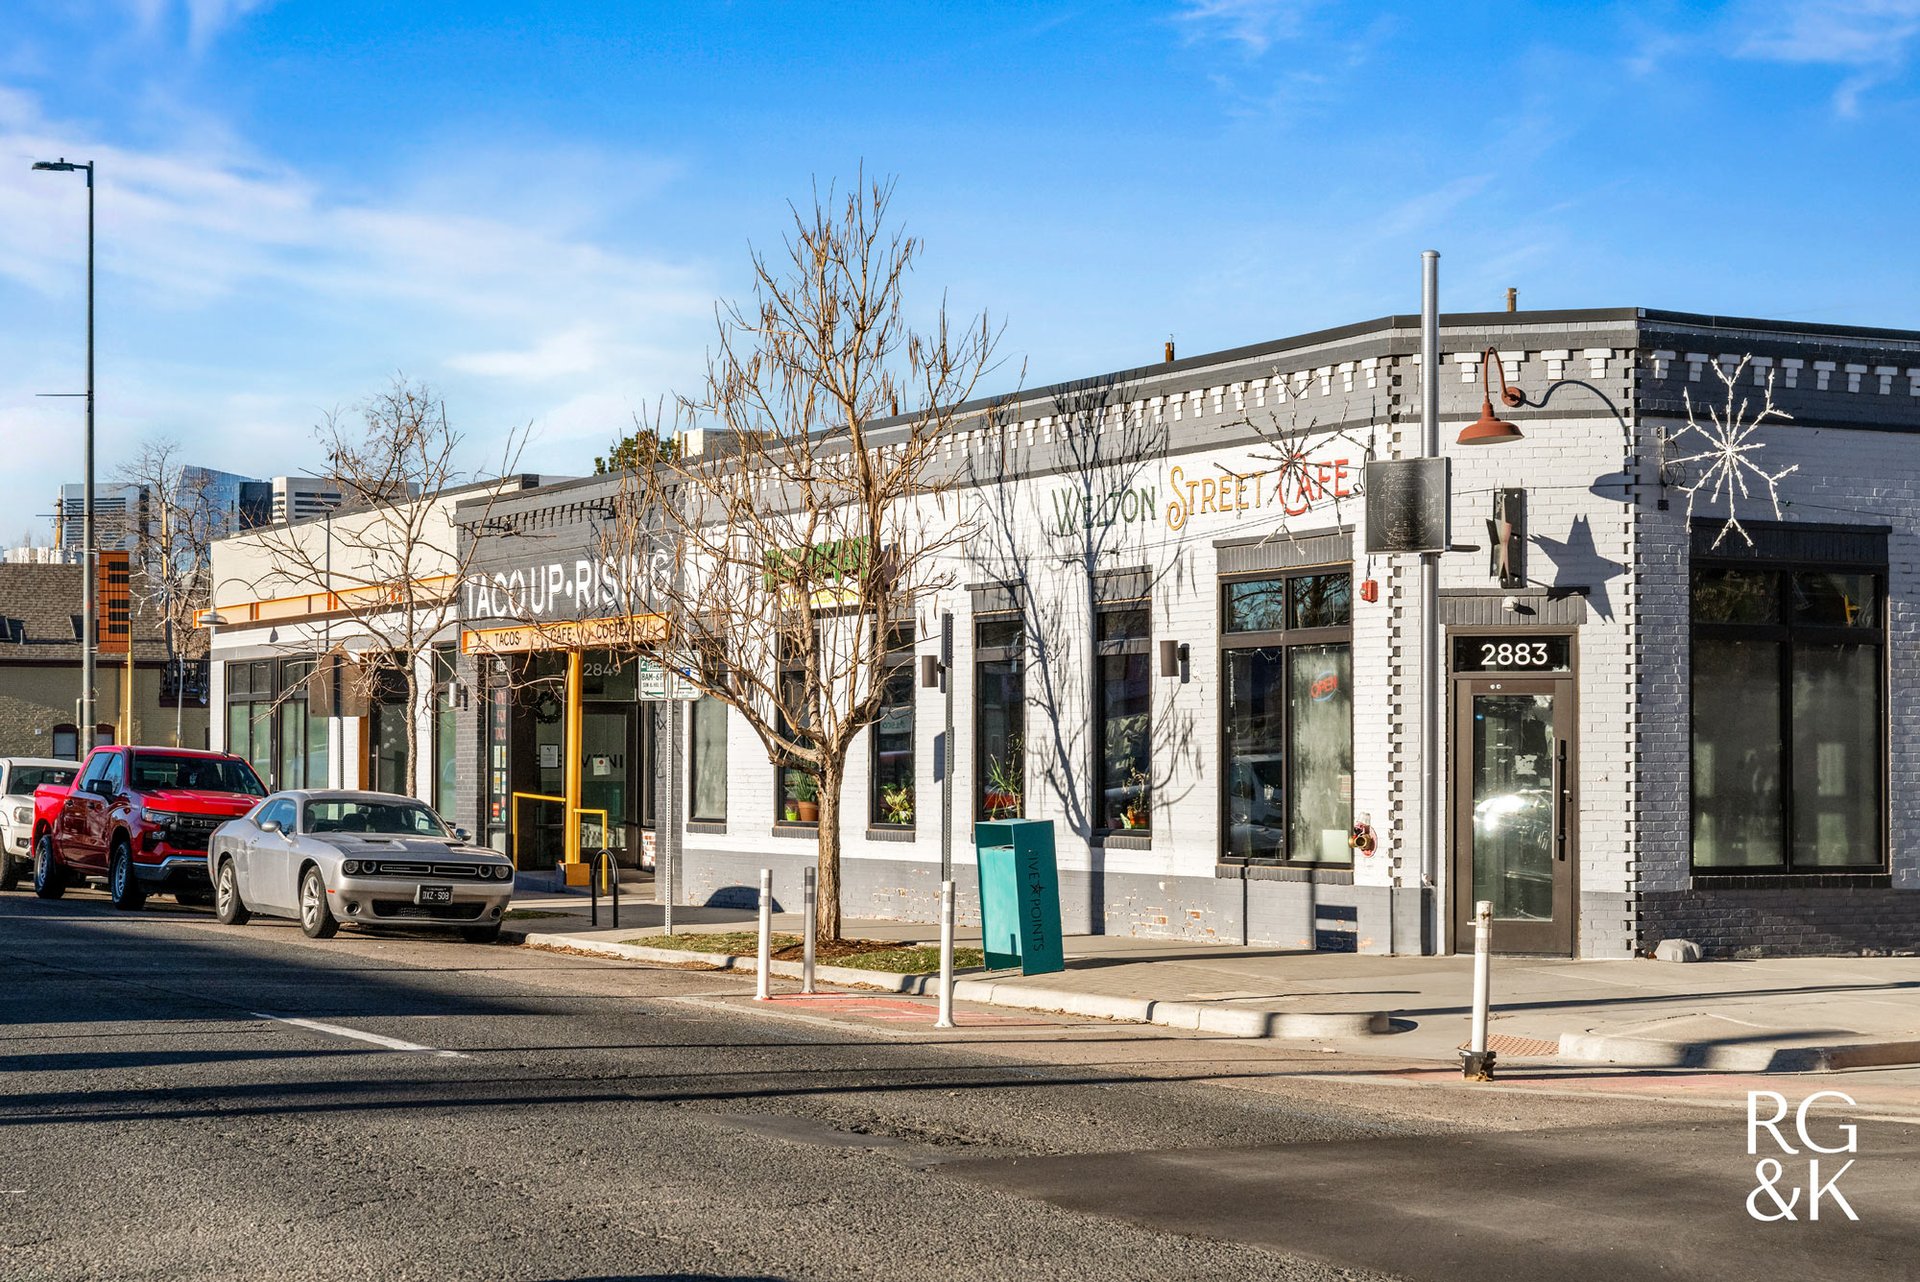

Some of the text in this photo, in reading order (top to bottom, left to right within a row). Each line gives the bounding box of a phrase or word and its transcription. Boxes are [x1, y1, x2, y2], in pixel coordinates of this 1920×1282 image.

[1052, 485, 1157, 535] WELTON
[1166, 466, 1268, 531] STREET
[1279, 452, 1350, 516] CAFE
[494, 630, 520, 647] TACOS
[1481, 643, 1548, 665] 2883
[583, 662, 621, 676] 2849
[1311, 674, 1338, 699] OPEN
[1031, 899, 1045, 951] POINTS
